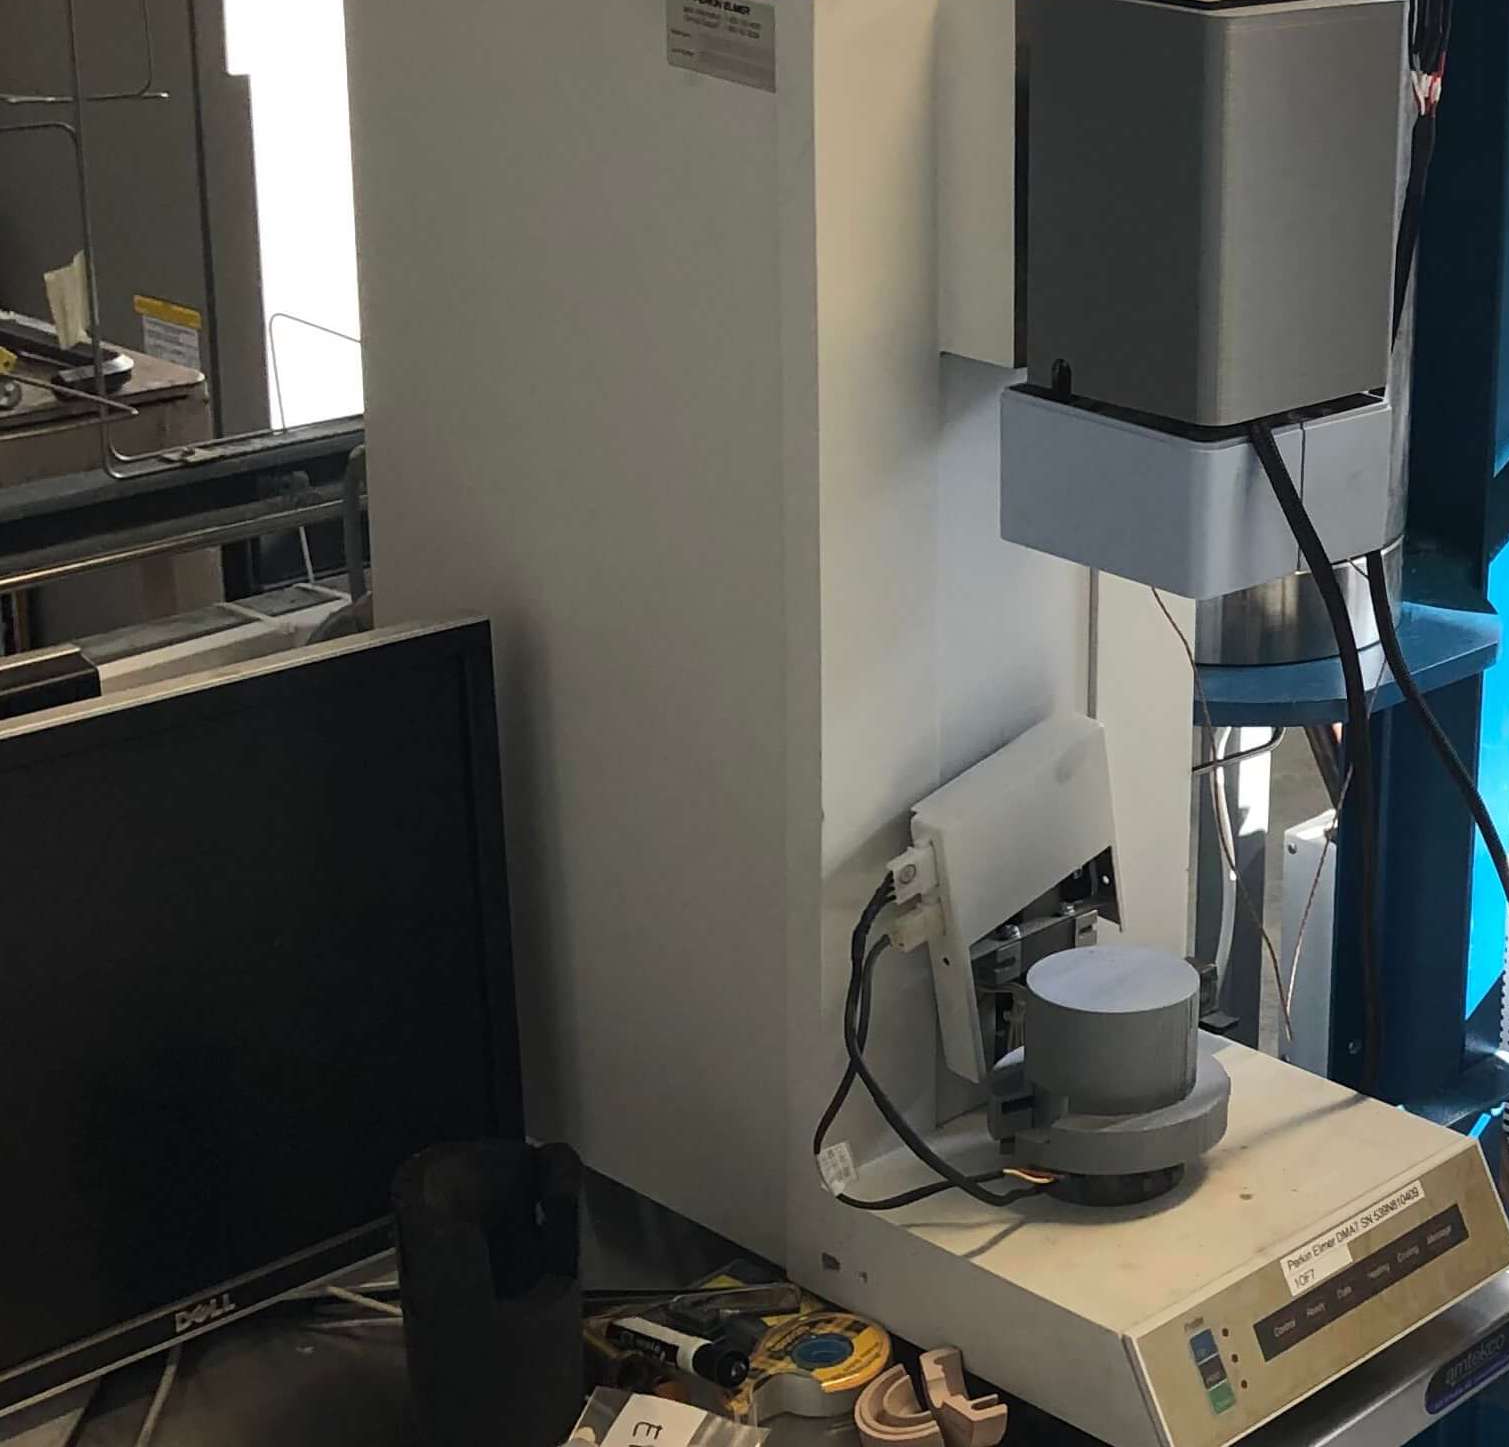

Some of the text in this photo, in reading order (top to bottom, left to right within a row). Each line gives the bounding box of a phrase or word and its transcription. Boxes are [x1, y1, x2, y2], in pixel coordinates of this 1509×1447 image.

[1287, 1251, 1313, 1272] Perkin
[1312, 1238, 1336, 1257] Elmer
[1336, 1221, 1359, 1243] DMA7
[175, 1293, 236, 1333] DELL
